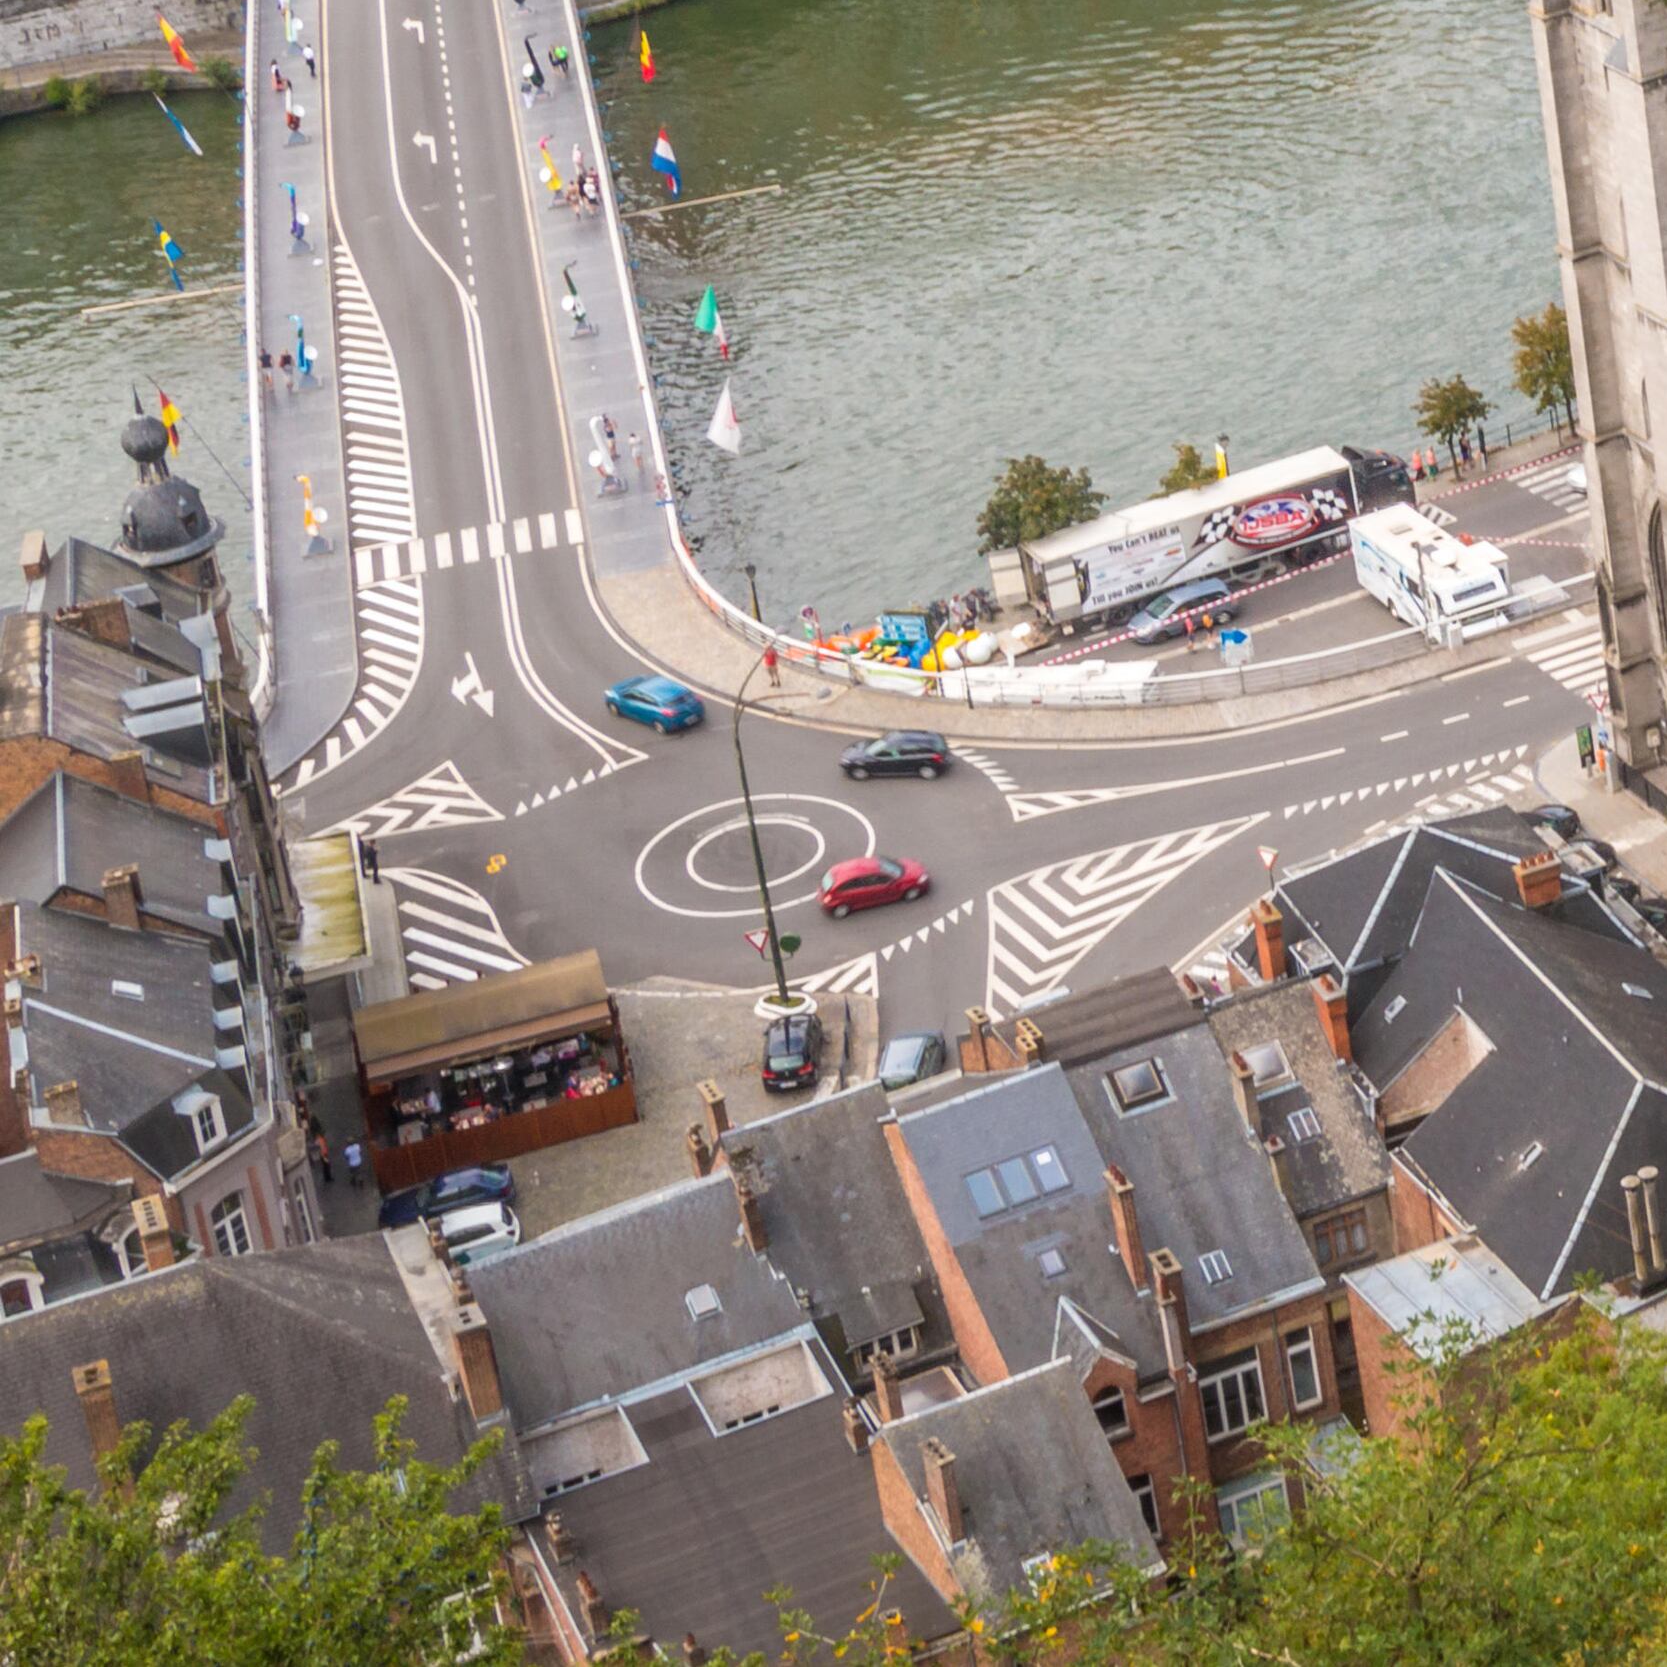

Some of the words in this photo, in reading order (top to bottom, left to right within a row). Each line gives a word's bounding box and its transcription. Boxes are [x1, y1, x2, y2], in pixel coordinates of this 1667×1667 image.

[1108, 545, 1123, 555] You
[1126, 535, 1147, 549] Can't
[1148, 527, 1167, 541] BEAT
[1092, 594, 1105, 606] Till
[1107, 589, 1123, 601] you
[1125, 581, 1144, 594] JOIN
